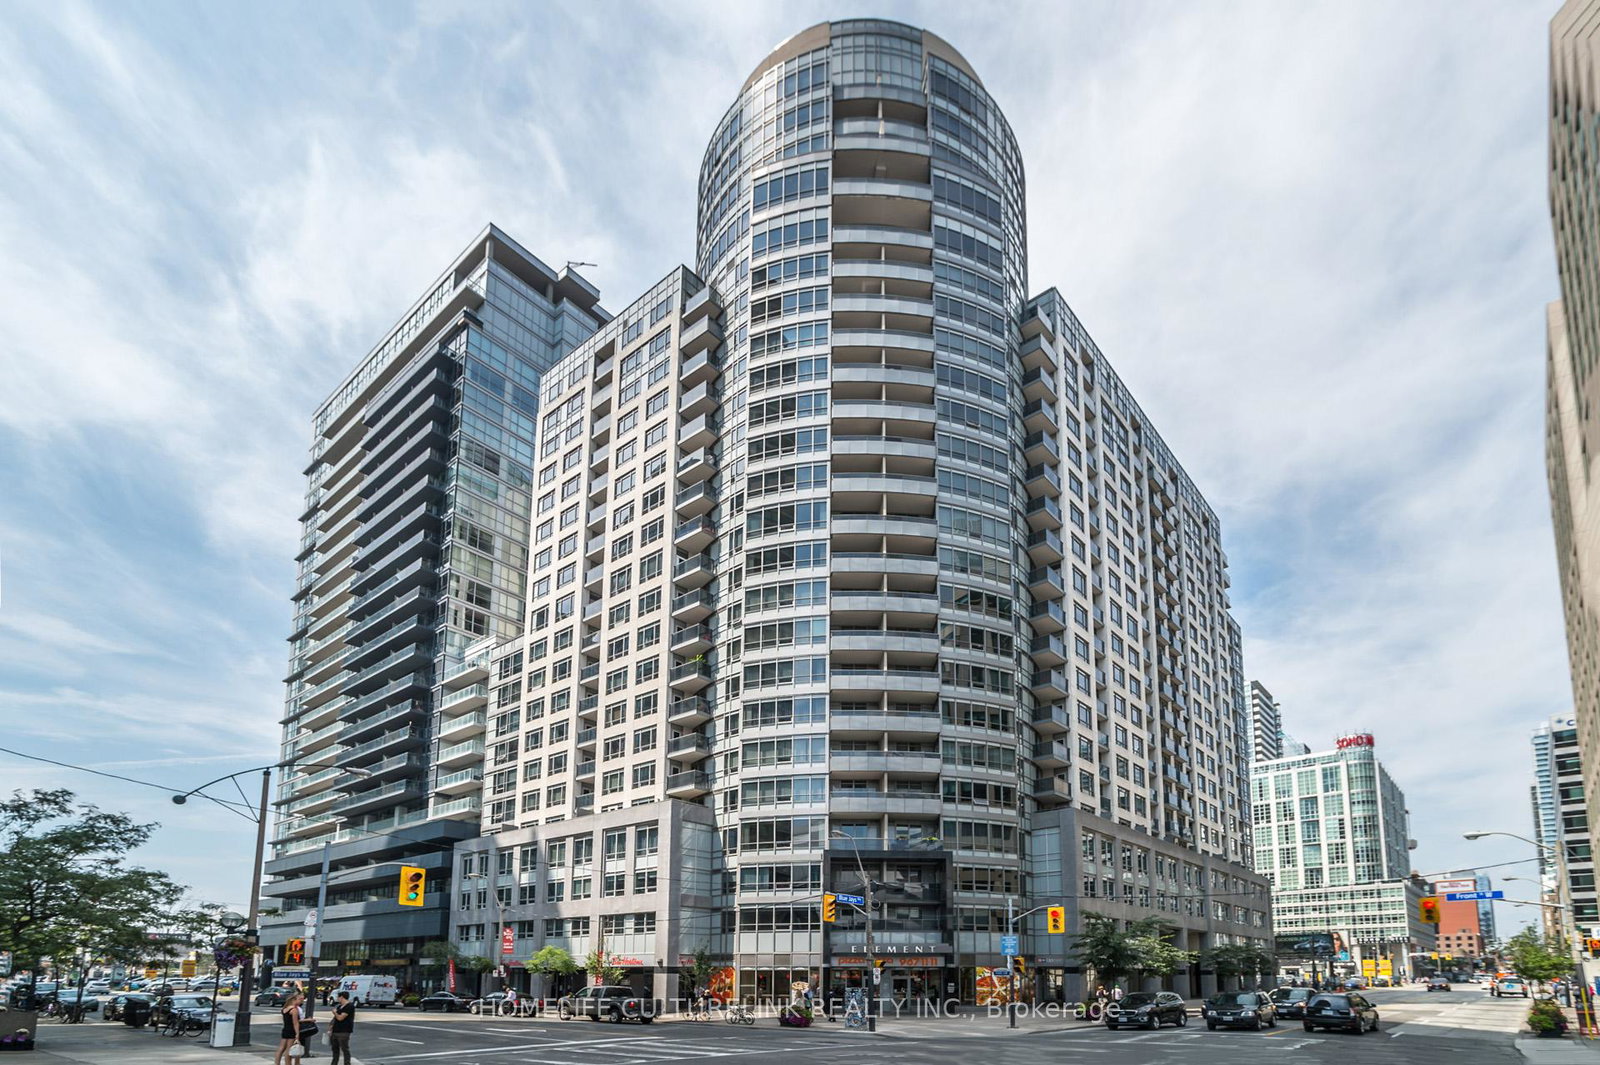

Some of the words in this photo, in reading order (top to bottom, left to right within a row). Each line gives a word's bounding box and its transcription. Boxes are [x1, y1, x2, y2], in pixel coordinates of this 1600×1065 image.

[848, 896, 857, 904] Jays
[1455, 892, 1478, 900] Front
[851, 945, 936, 953] ELEMENT
[343, 981, 358, 990] FedEx
